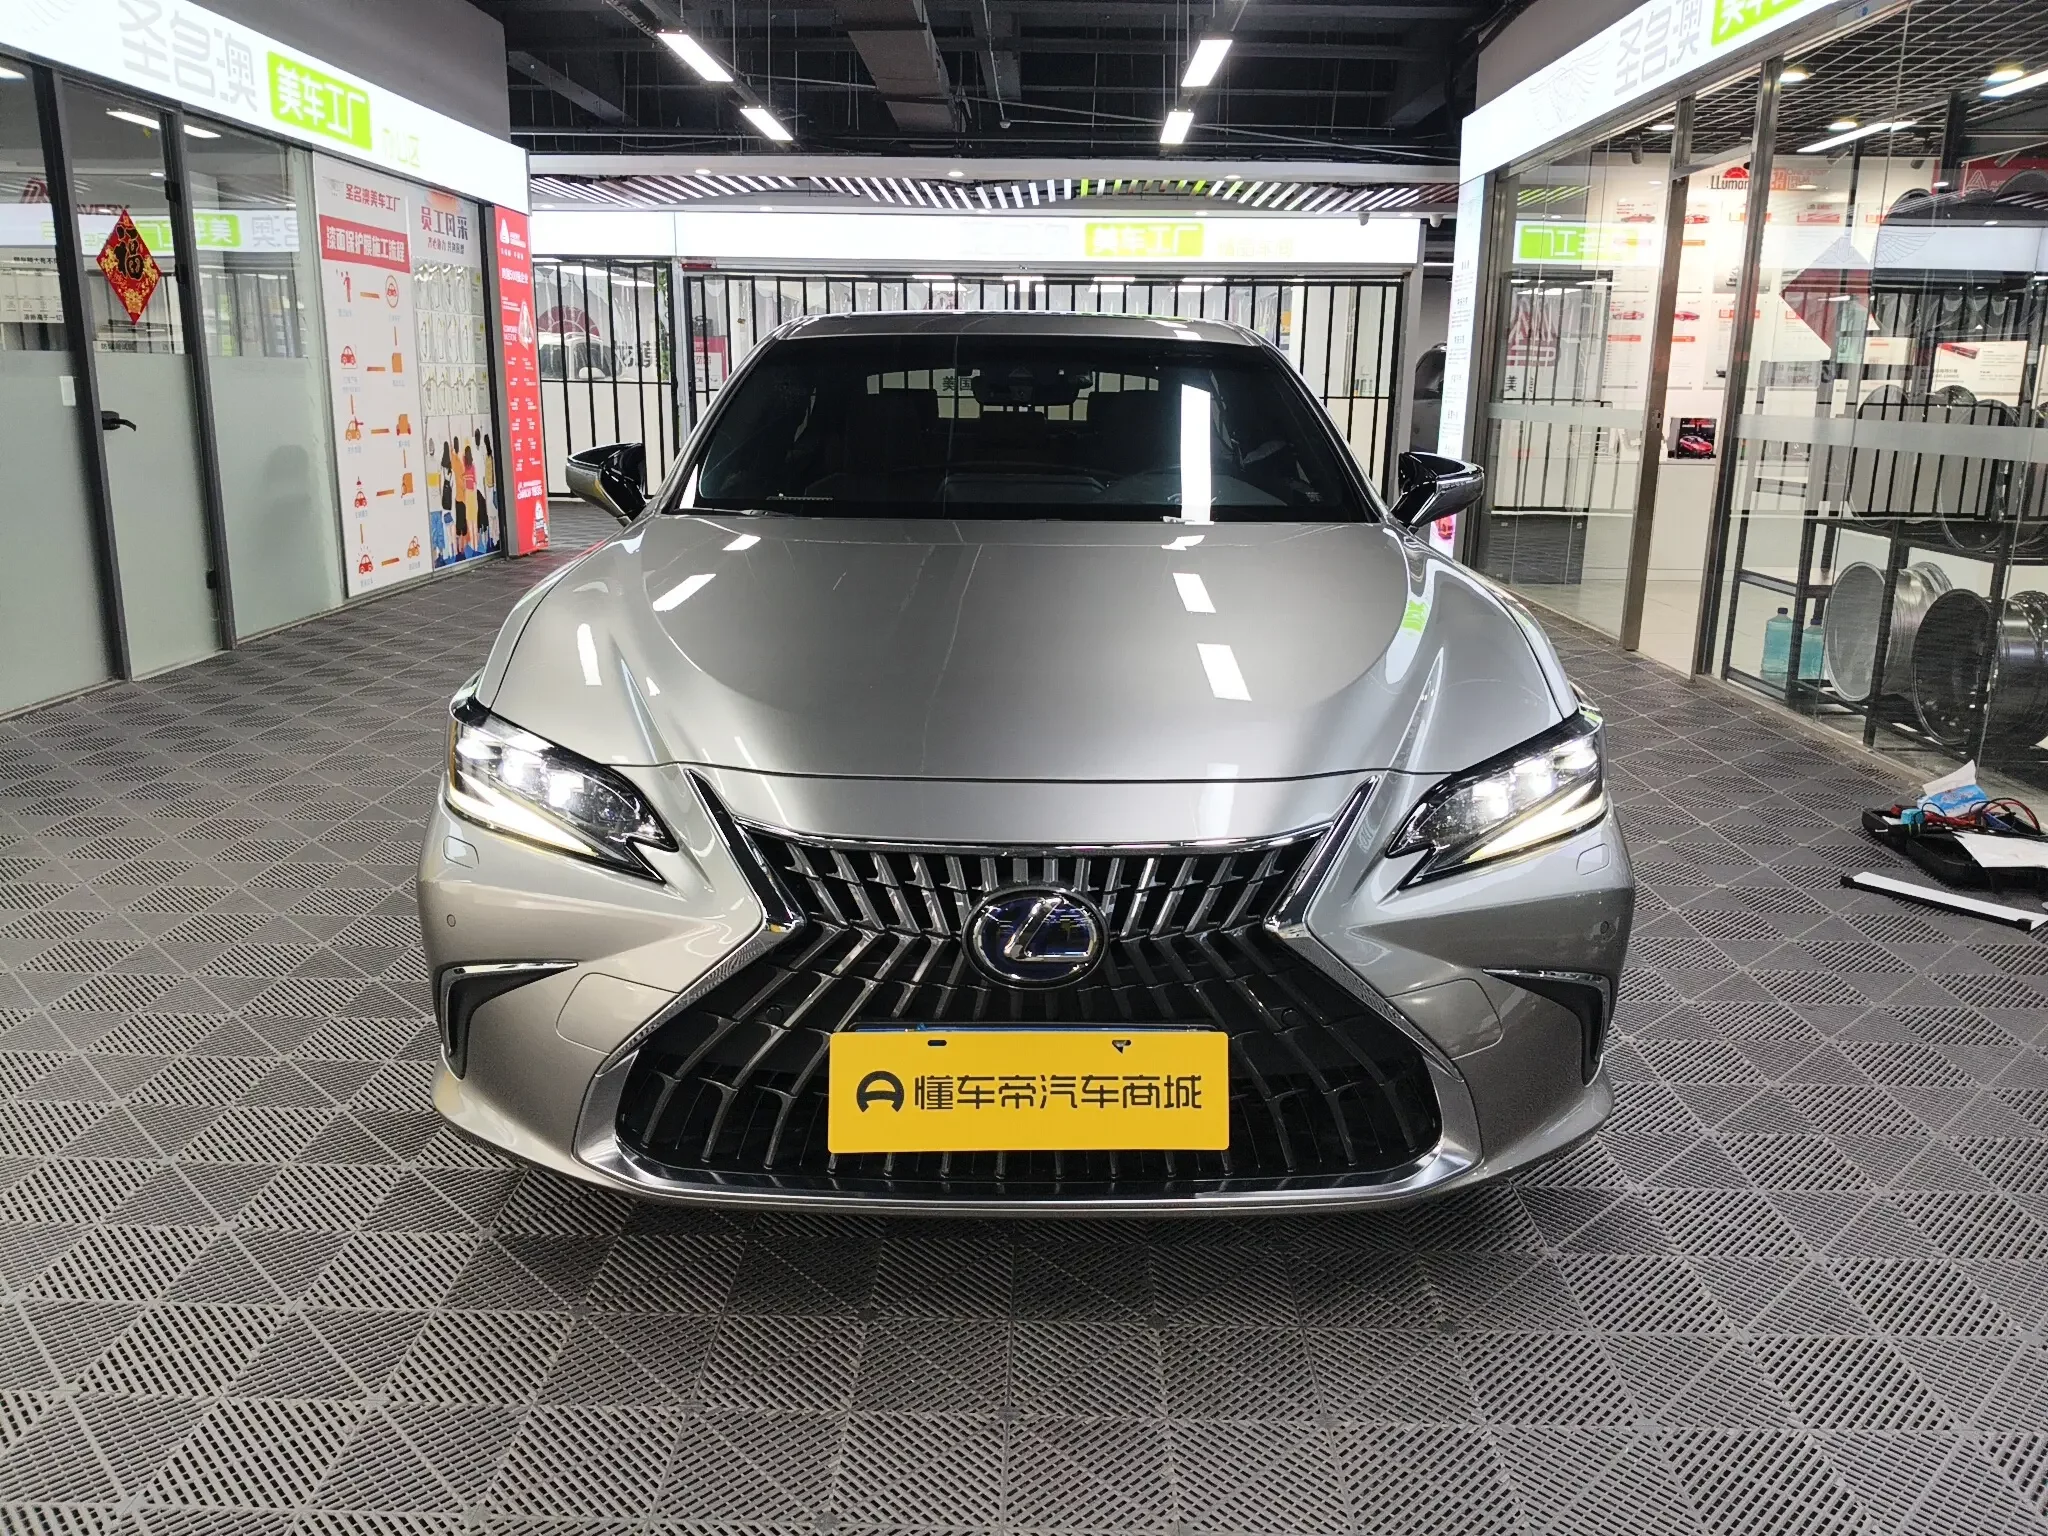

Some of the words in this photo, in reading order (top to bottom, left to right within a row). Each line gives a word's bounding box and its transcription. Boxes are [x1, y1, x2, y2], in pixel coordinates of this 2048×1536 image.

[1614, 0, 1701, 96] 圣名澳
[118, 0, 257, 112] 圣名澳
[277, 64, 367, 139] 美车工厂
[346, 183, 400, 212] 圣名澳美车工厂
[421, 206, 468, 240] 员工风采
[1094, 225, 1201, 256] 美车工厂
[326, 225, 405, 263] 漆面保护膜施工流程
[914, 1073, 1202, 1110] 懂车帝汽车商城
